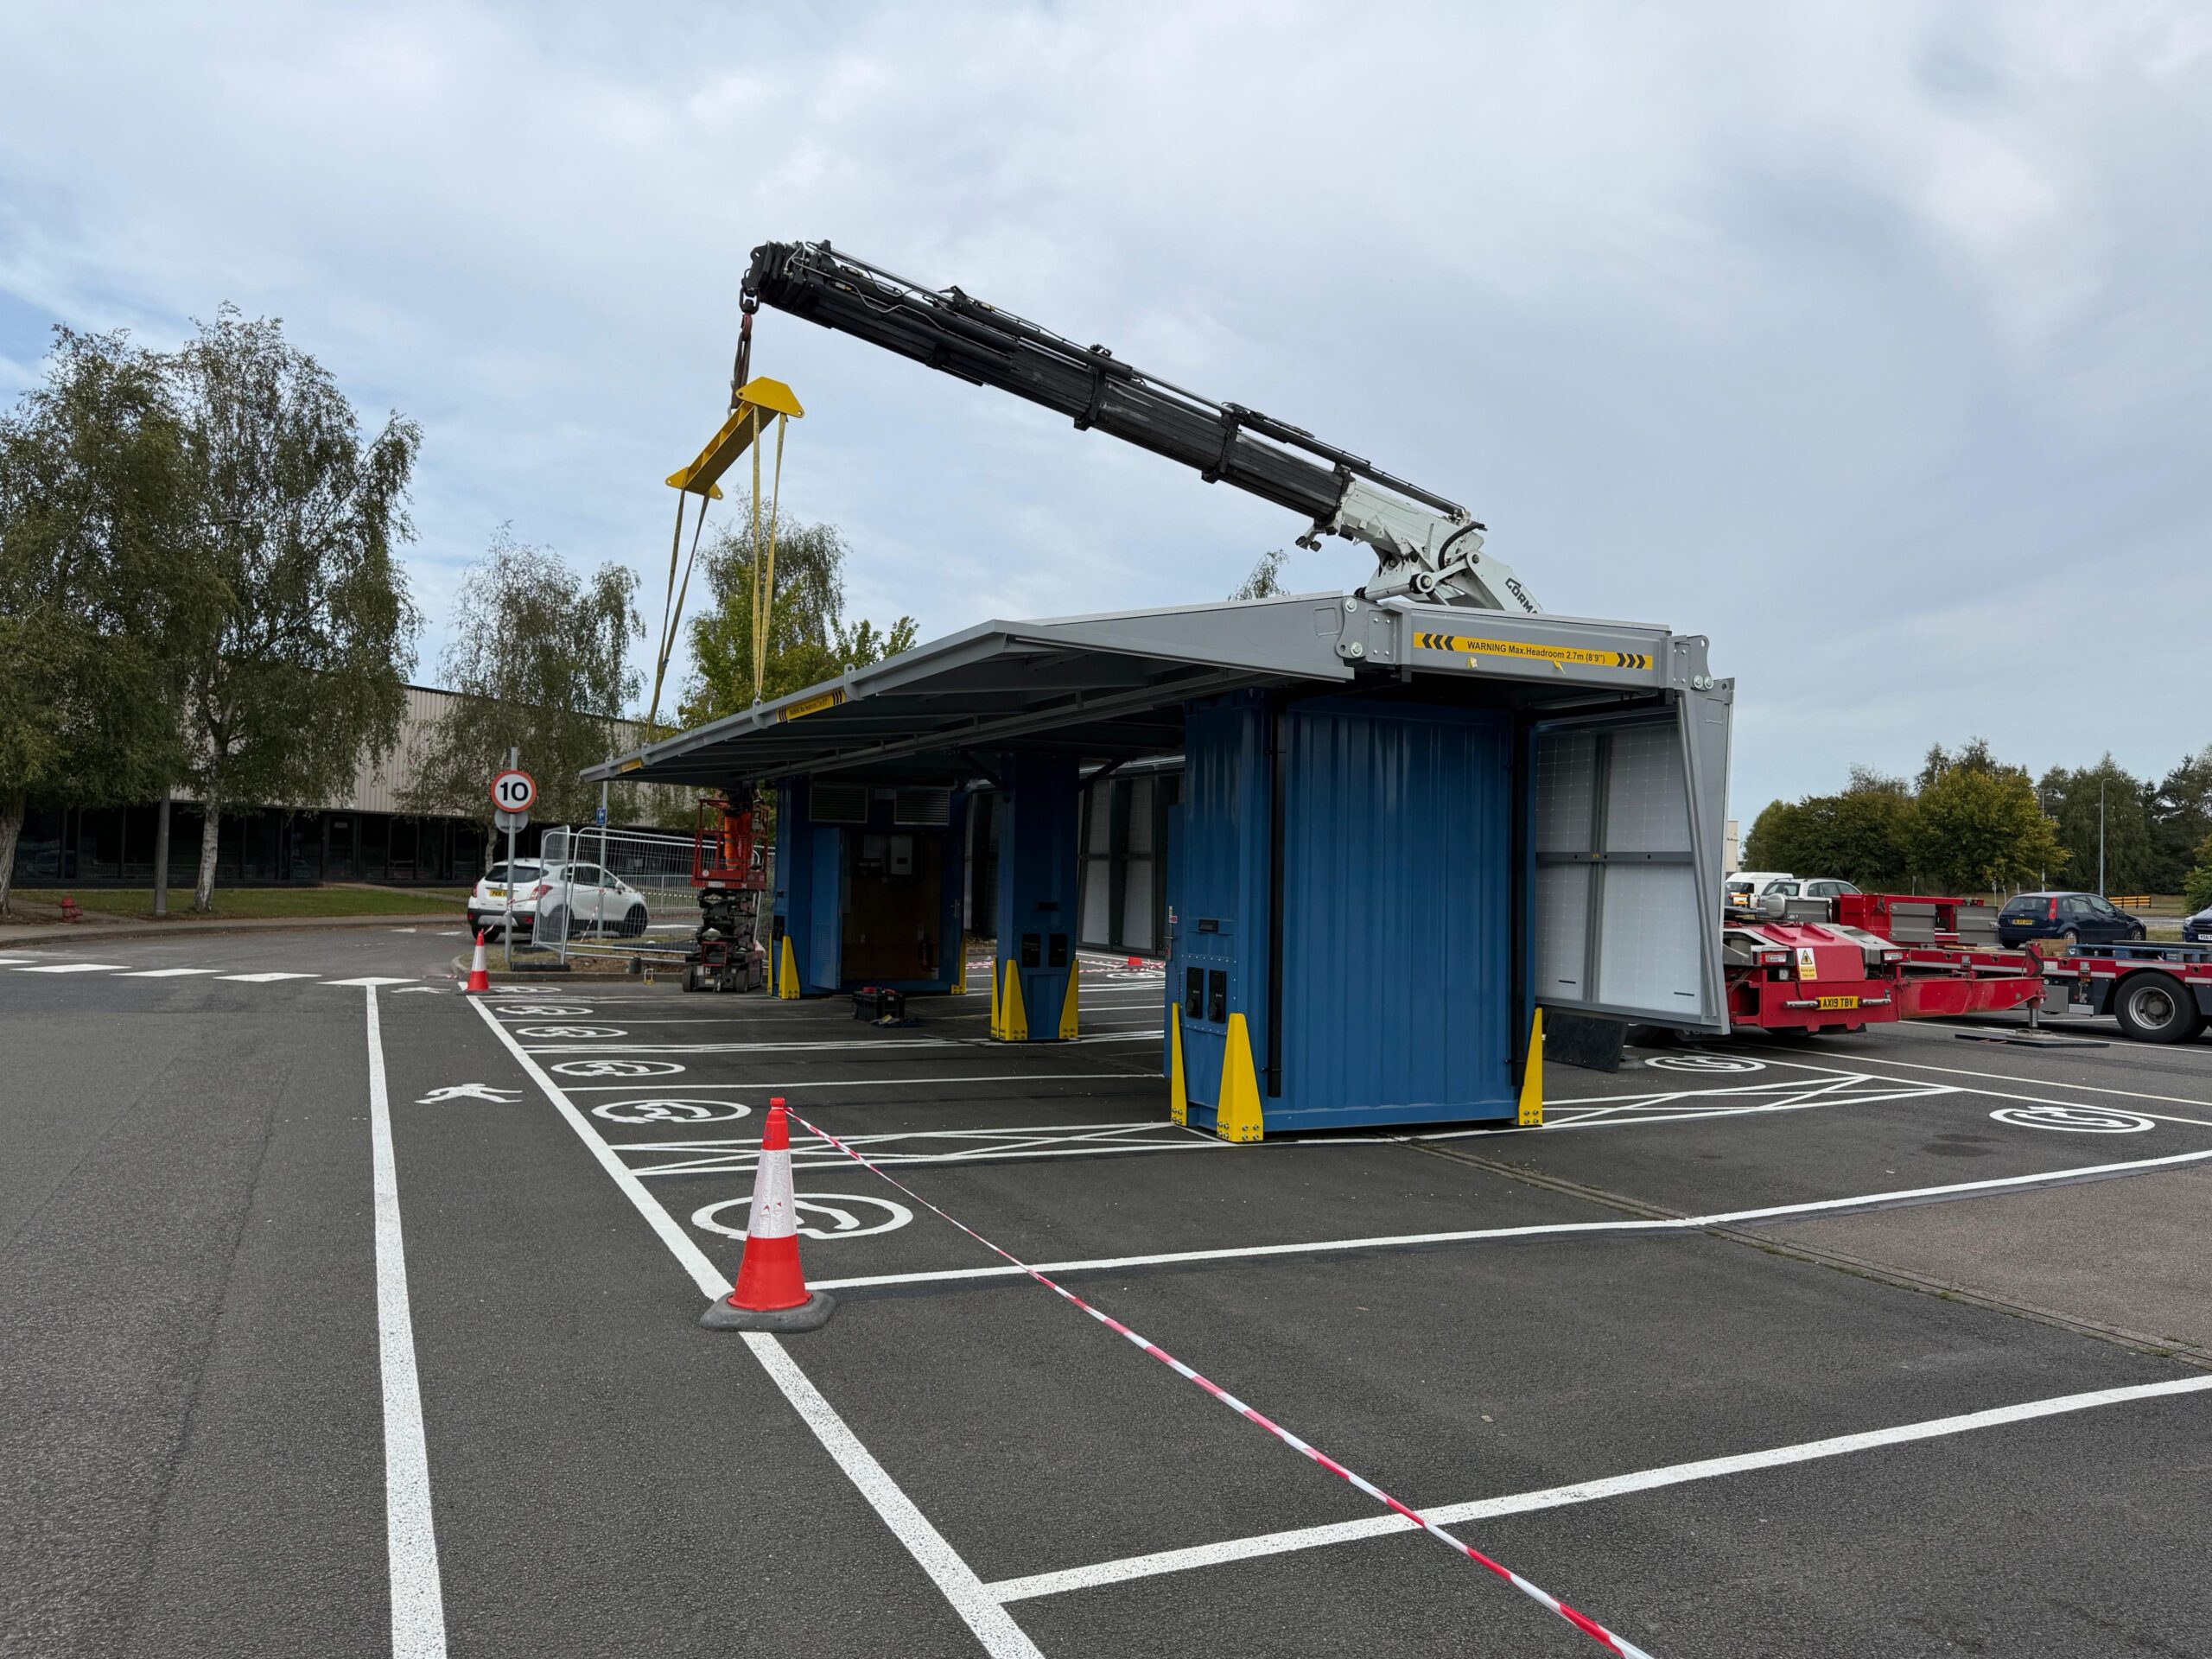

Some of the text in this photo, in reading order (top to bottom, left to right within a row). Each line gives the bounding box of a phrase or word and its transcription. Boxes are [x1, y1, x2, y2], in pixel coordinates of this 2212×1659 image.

[1467, 641, 1506, 652] WARNING
[1567, 651, 1584, 661] 2.7m
[500, 781, 529, 802] 10
[1822, 997, 1853, 1008] AX19 TBV
